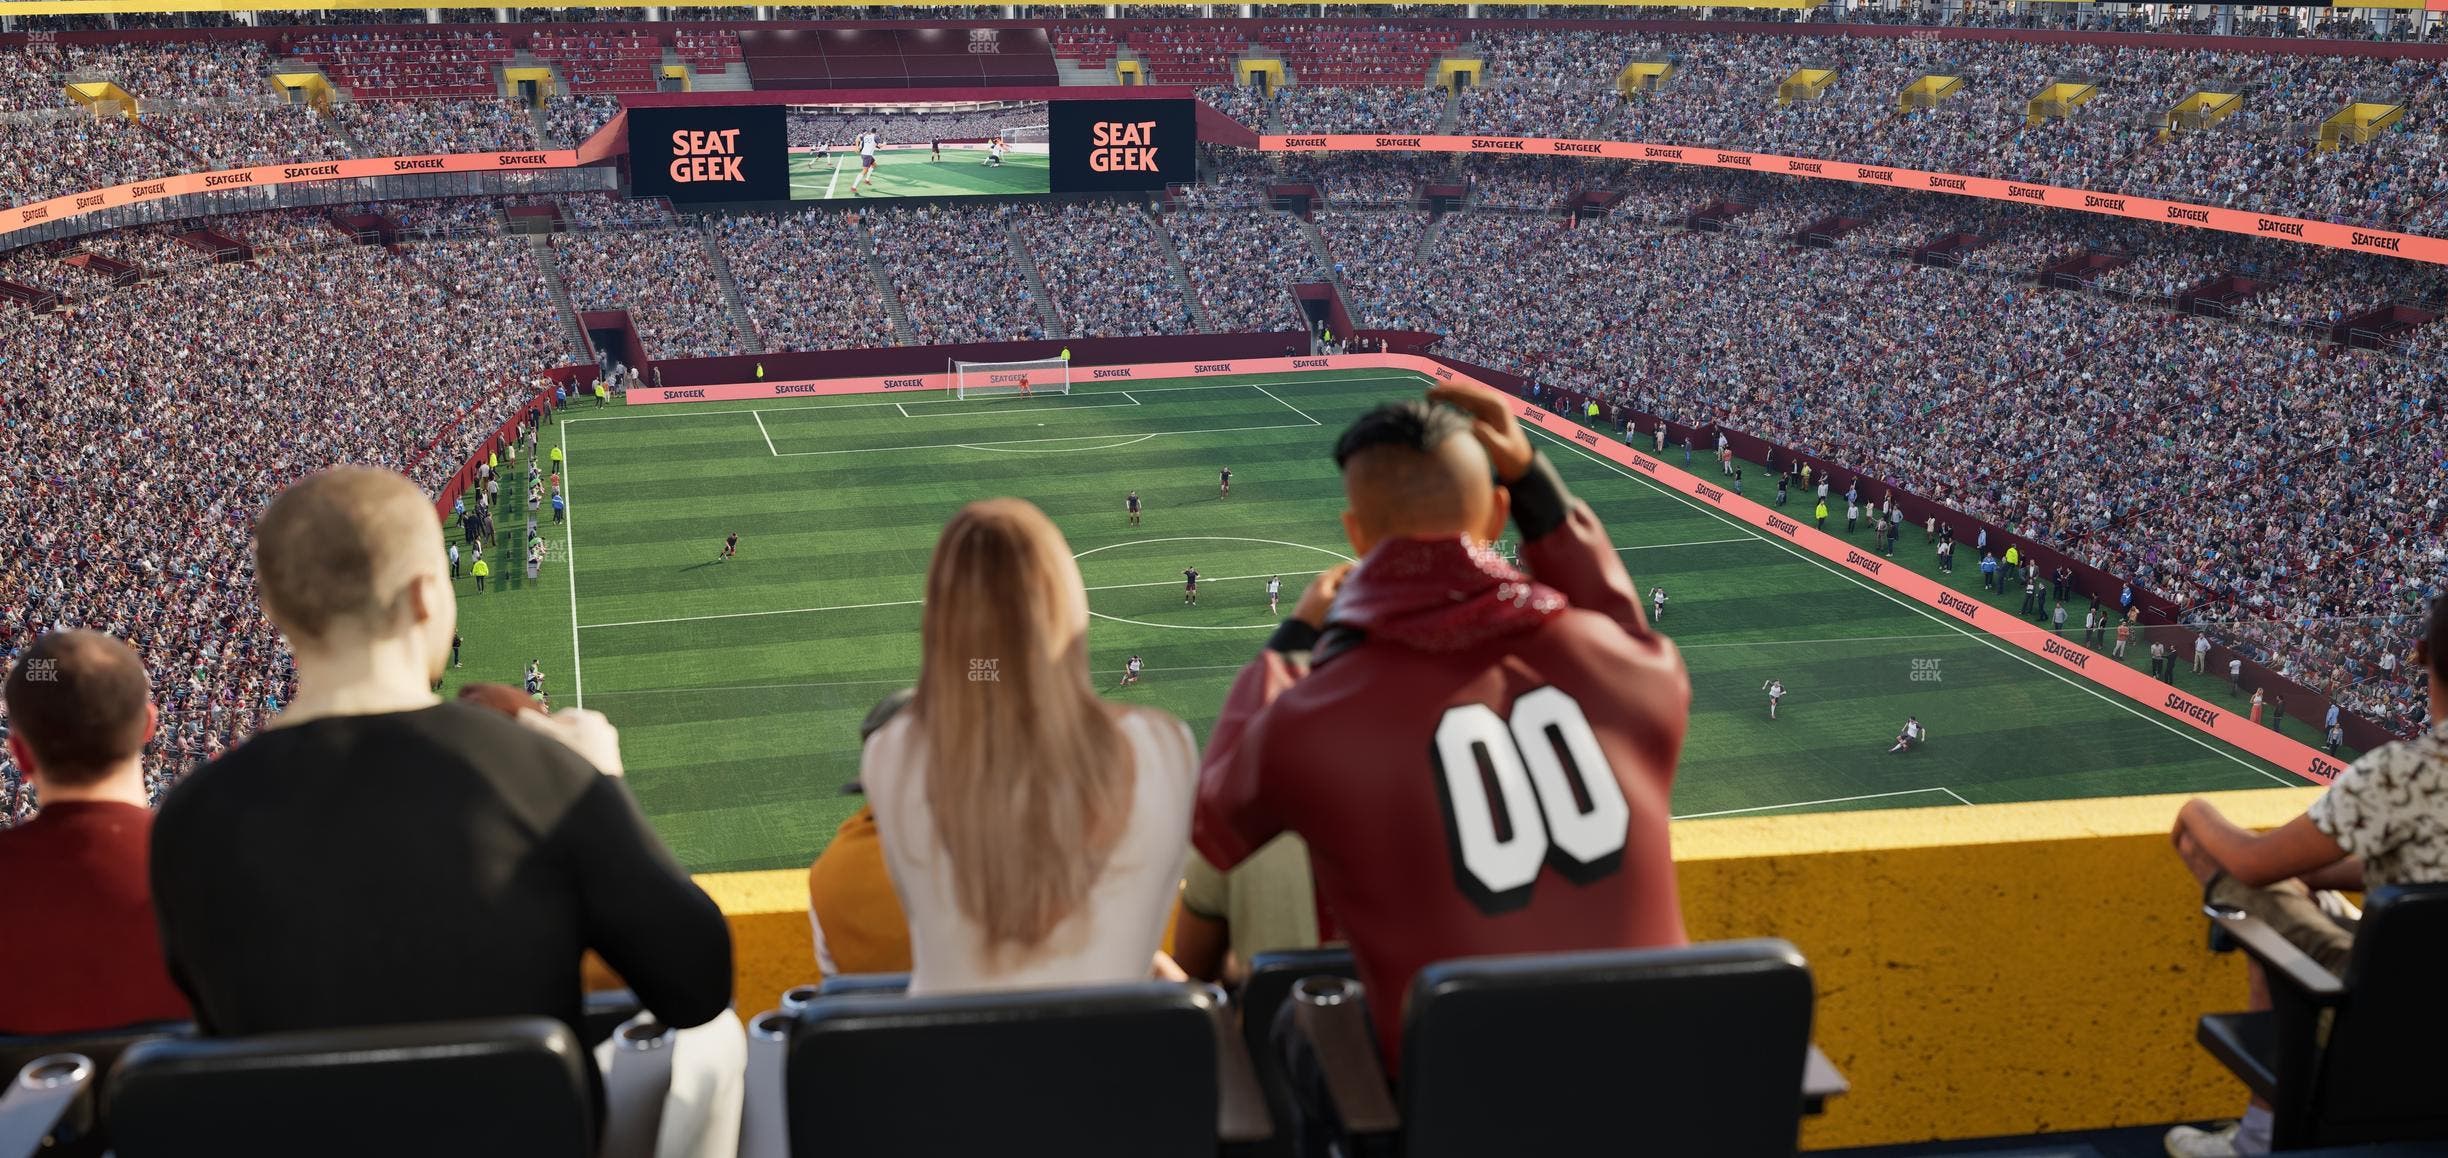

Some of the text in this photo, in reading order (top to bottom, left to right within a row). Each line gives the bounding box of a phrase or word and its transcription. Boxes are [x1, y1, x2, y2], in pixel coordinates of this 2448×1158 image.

[1093, 121, 1156, 146] SEAT
[672, 128, 740, 156] SEAT
[1286, 138, 1327, 148] SEATGEEK
[1376, 139, 1421, 148] SEATGEEK
[1472, 140, 1524, 150] SEATGEEK
[1555, 143, 1602, 154] SEATGEEK
[500, 155, 547, 166] SEATGEEK
[1090, 147, 1159, 172] GEEK
[1646, 148, 1683, 160] SEATGEEK
[1718, 154, 1752, 166] SEATGEEK
[285, 165, 340, 179] SEATGEEK
[395, 159, 445, 171] SEATGEEK
[670, 156, 745, 183] GEEK
[1789, 161, 1823, 174] SEATGEEK
[206, 172, 253, 187] SEATGEEK
[1858, 169, 1894, 182] SEATGEEK
[133, 183, 166, 198] SEATGEEK
[1930, 177, 1967, 191] SEATGEEK
[2009, 186, 2046, 201] SEATGEEK
[77, 196, 105, 210] SEATGEEK
[2085, 196, 2126, 212] SEATGEEK
[23, 208, 48, 223] SEATGEEK
[2168, 207, 2209, 224] SEATGEEK
[2258, 219, 2304, 238] SEATGEEK
[2352, 232, 2401, 252] SEATGEEK
[1195, 364, 1231, 374] SEATGEEK
[1293, 359, 1329, 369] SEATGEEK
[1094, 369, 1132, 379] SEATGEEK
[776, 384, 816, 395] SEATGEEK
[884, 379, 924, 389] SEATGEEK
[664, 390, 705, 400] SEATGEEK
[1524, 406, 1544, 422] SEATGEEK
[1575, 429, 1599, 446] SEATGEEK
[1631, 454, 1658, 473] SEATGEEK
[1694, 482, 1724, 502] SEATGEEK
[1766, 514, 1799, 536] SEATGEEK
[1847, 551, 1883, 576] SEATGEEK
[1938, 592, 1979, 619] SEATGEEK
[2043, 639, 2090, 669] SEATGEEK
[2165, 693, 2220, 729] SEATGEEK
[1432, 684, 1630, 901] 00
